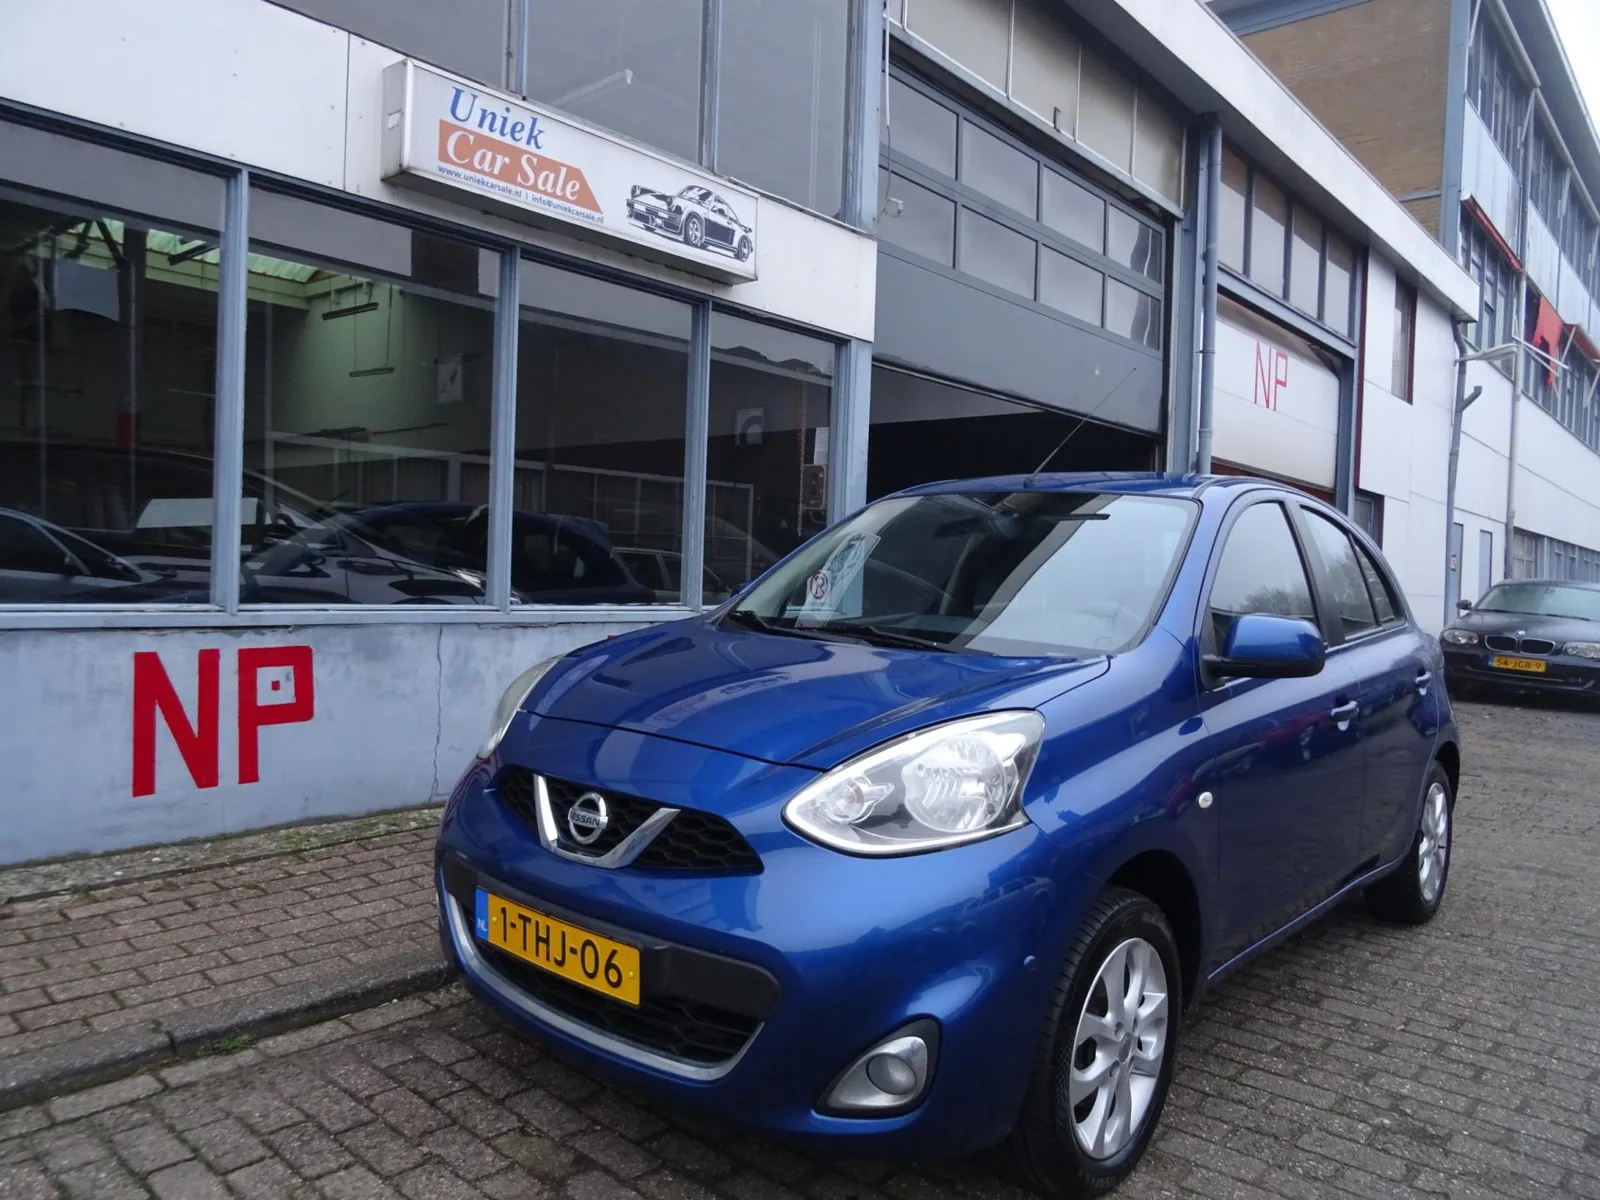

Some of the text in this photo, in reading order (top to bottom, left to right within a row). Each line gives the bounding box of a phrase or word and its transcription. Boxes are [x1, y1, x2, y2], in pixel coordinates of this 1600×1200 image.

[449, 86, 545, 150] Uniek
[437, 165, 522, 198] www.uniekcarsale.nl
[531, 194, 604, 225] info@uniekcarsale.nl
[446, 130, 580, 201] Car Sale
[1253, 340, 1289, 412] NP
[132, 645, 314, 798] NP
[570, 810, 600, 826] NISSAN
[477, 918, 488, 931] NL
[501, 906, 623, 988] 1-THJ-06
